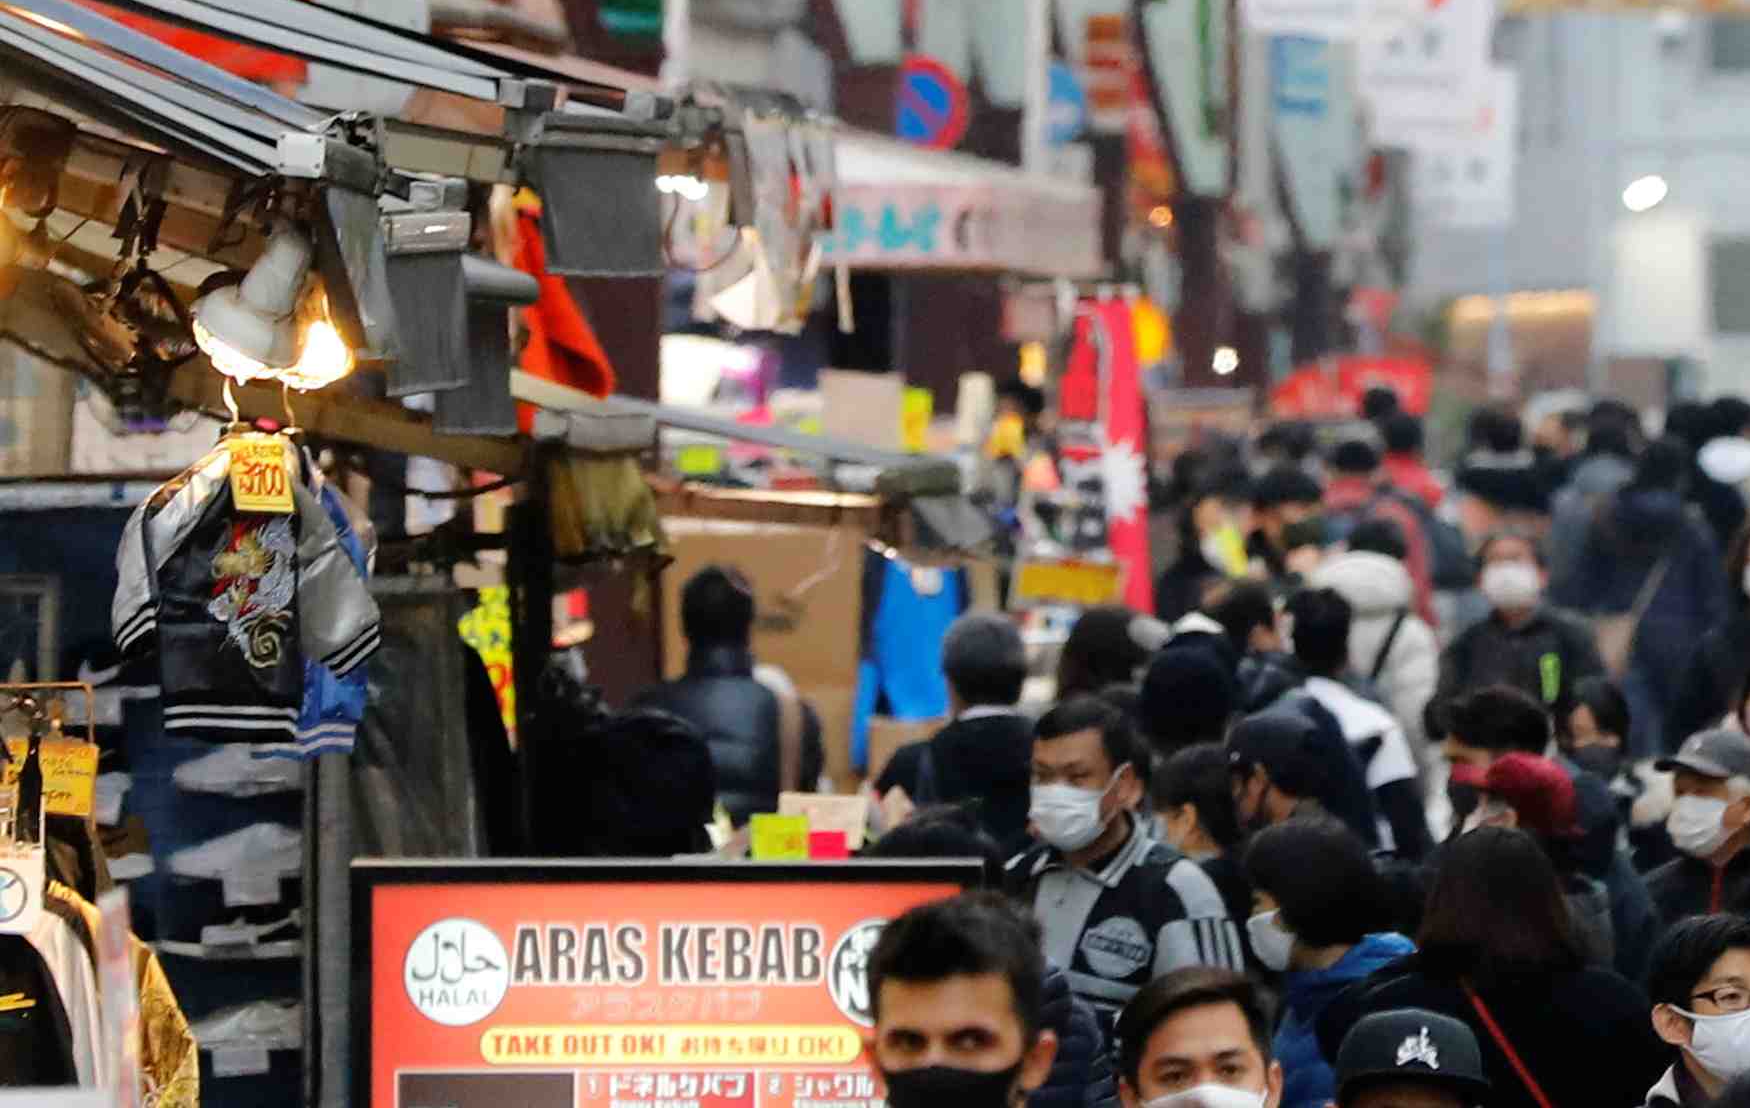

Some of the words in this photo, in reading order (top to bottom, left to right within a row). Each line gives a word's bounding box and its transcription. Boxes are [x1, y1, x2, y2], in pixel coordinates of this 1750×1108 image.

[514, 928, 643, 983] ARAS
[663, 928, 823, 983] KEBAB
[419, 988, 492, 1007] HALAL
[493, 1035, 553, 1056] TAKE
[563, 1035, 614, 1056] OUT
[622, 1035, 665, 1056] OK!
